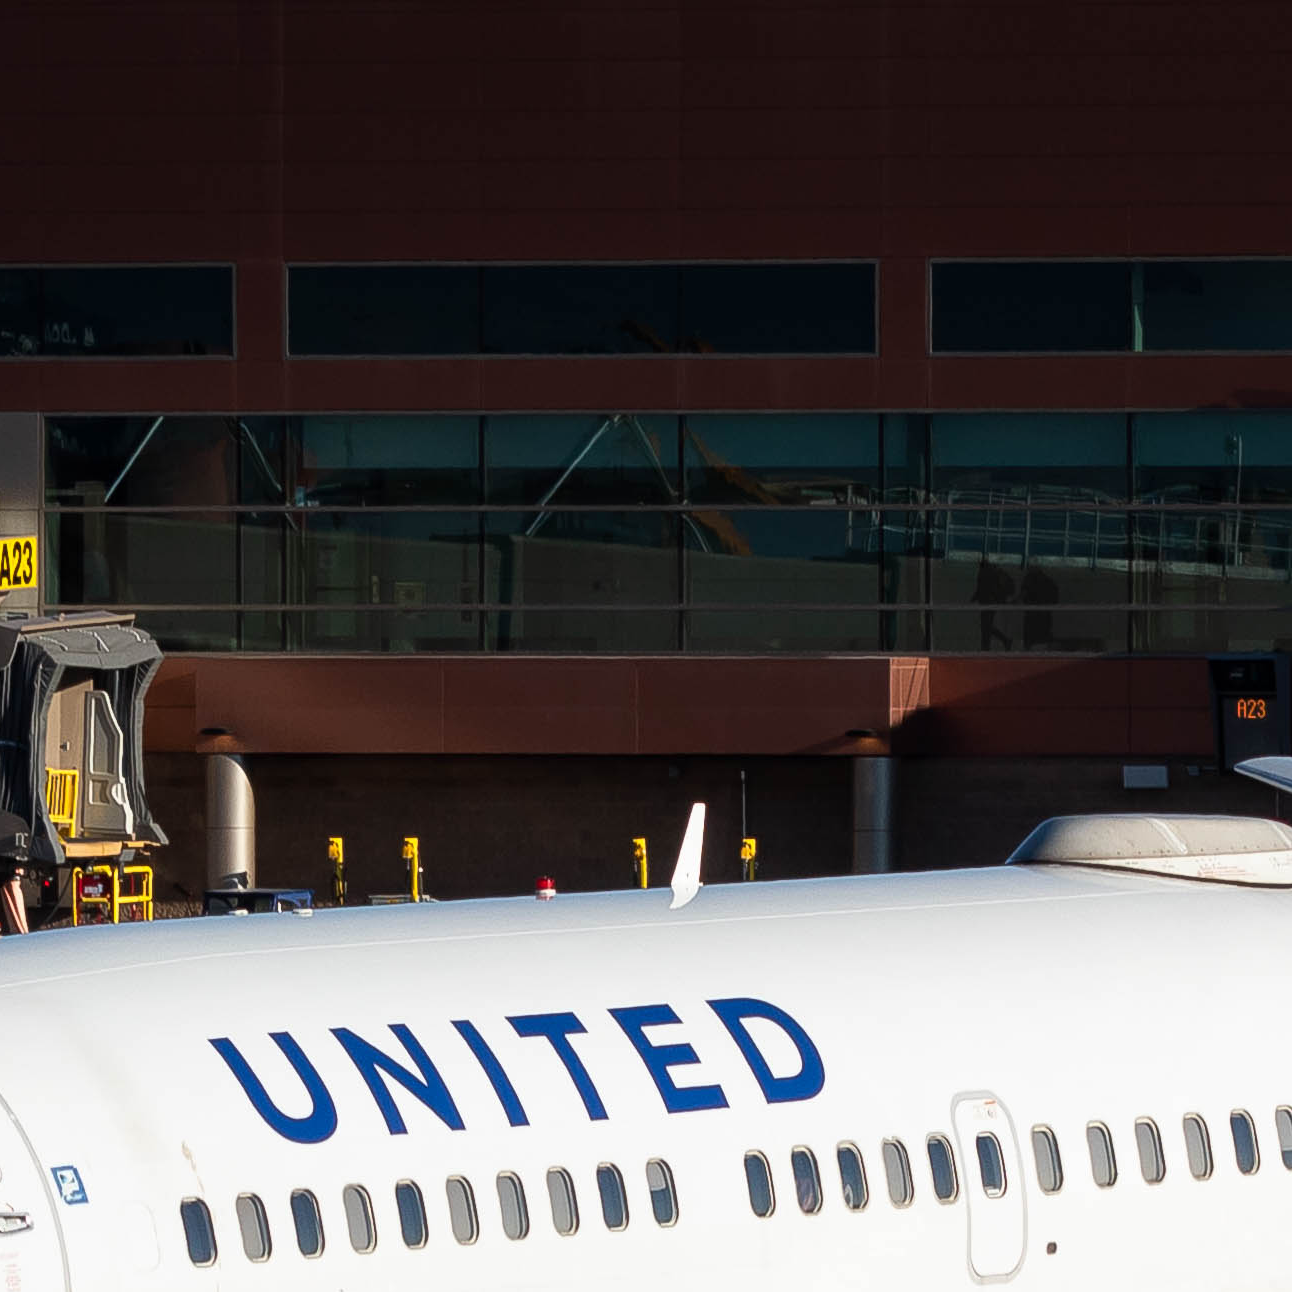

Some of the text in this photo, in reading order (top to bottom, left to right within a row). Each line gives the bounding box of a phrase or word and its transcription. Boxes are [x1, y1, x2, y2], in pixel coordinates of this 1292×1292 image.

[0, 541, 33, 587] A23
[1237, 698, 1267, 719] A23
[207, 997, 826, 1145] UNITED
